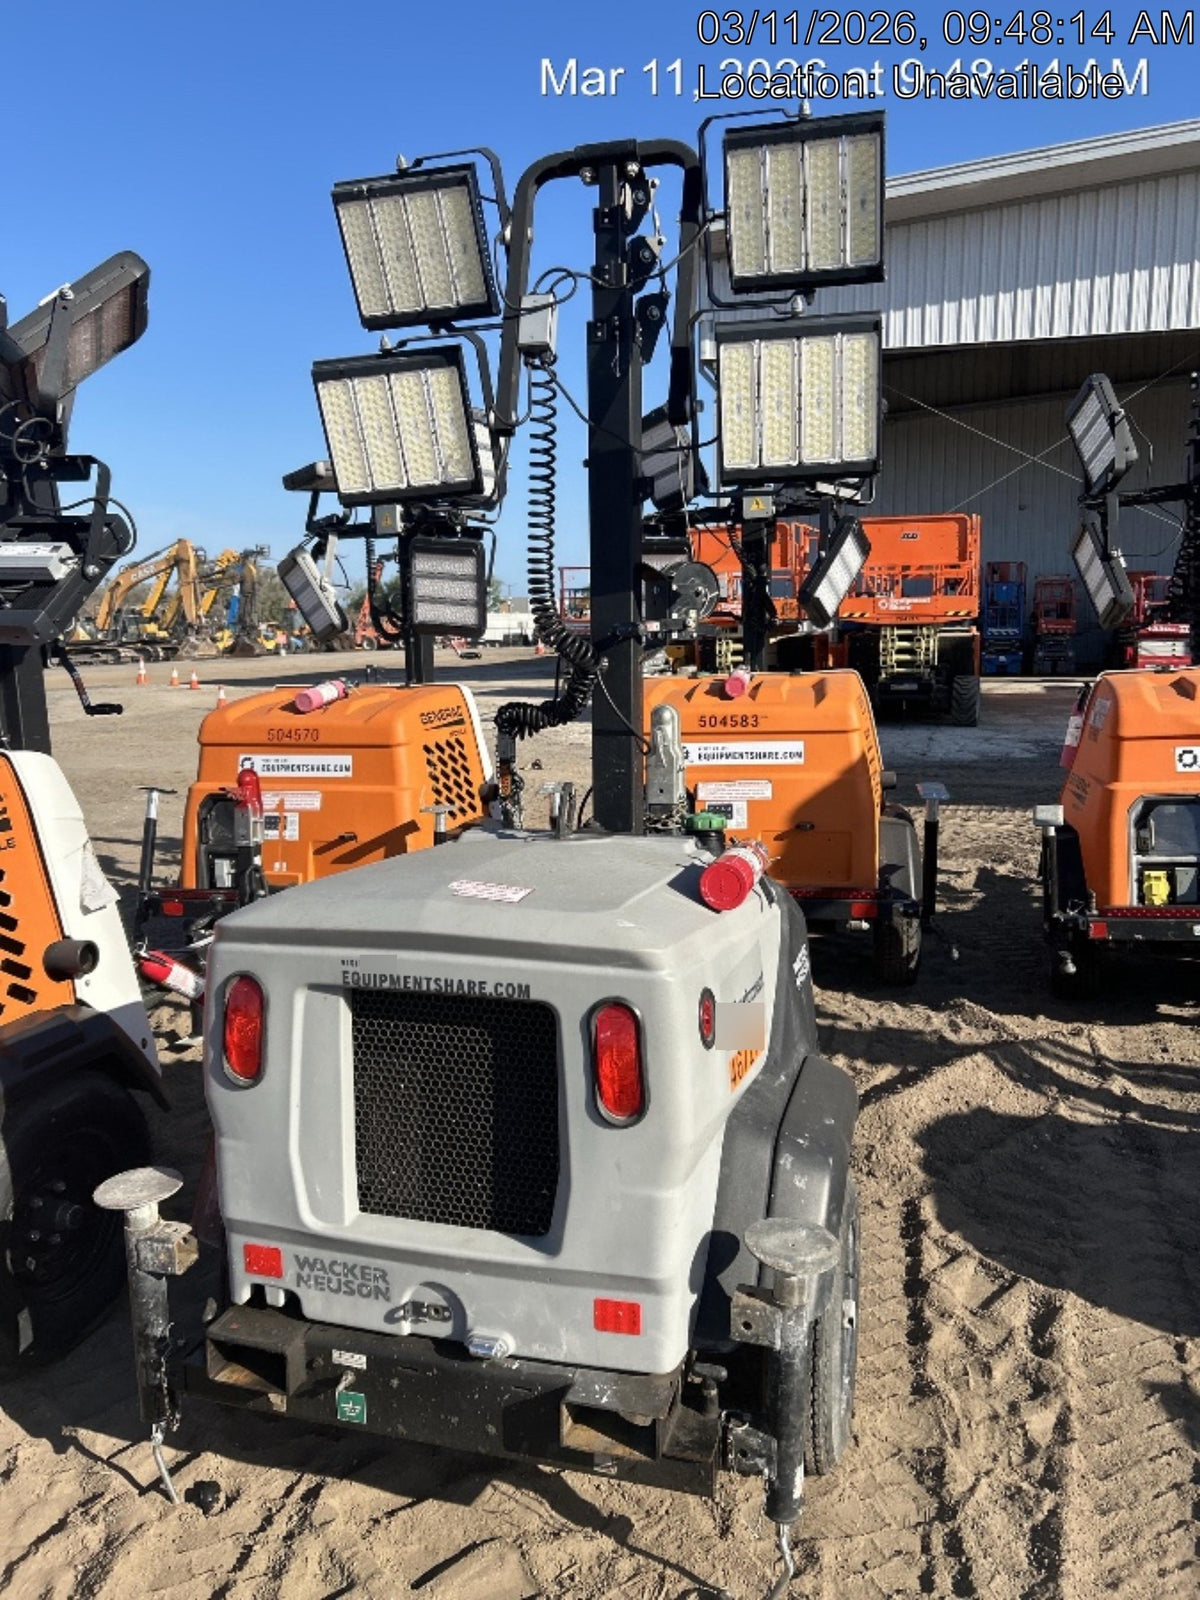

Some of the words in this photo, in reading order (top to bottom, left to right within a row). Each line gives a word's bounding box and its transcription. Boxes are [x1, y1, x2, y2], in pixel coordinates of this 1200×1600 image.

[698, 714, 760, 728] 504583
[267, 728, 320, 743] 504570
[698, 751, 802, 761] EQUIPMENTSHARE.COM
[342, 970, 530, 998] EQUIPMENTSHARE.COM
[293, 1254, 391, 1286] WACKER
[295, 1271, 392, 1303] NEUSON
